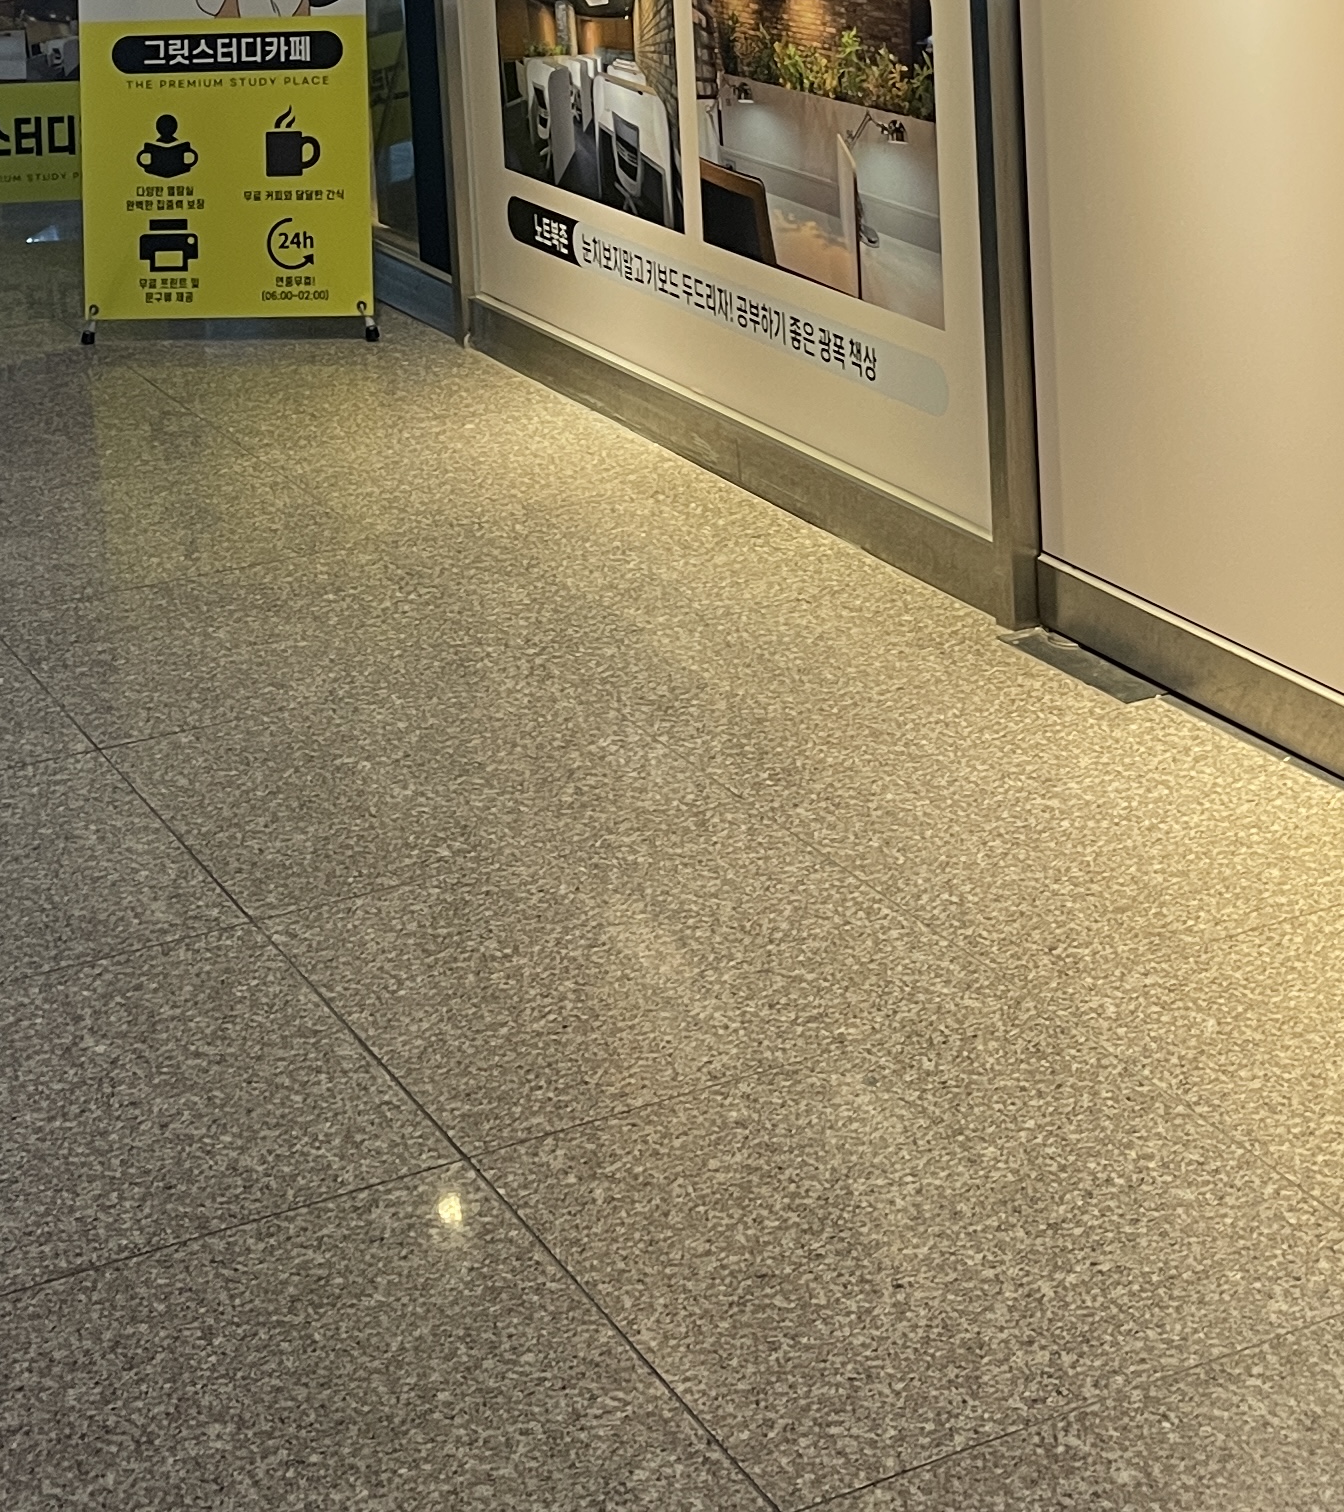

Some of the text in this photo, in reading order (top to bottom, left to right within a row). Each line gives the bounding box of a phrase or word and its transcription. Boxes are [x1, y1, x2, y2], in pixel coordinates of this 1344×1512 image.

[143, 35, 312, 66] 그릿스터디카페
[125, 75, 330, 90] THE PREMIUM STUDY PLACE
[27, 172, 67, 183] STUDY
[278, 230, 315, 250] 24h
[533, 213, 569, 255] 노트북존
[645, 258, 681, 300] 키보드
[682, 273, 735, 323] 두드리자!
[736, 294, 787, 346] 공부하기
[789, 315, 816, 357] 좋은
[818, 326, 846, 370] 광폭
[848, 337, 877, 382] 책상
